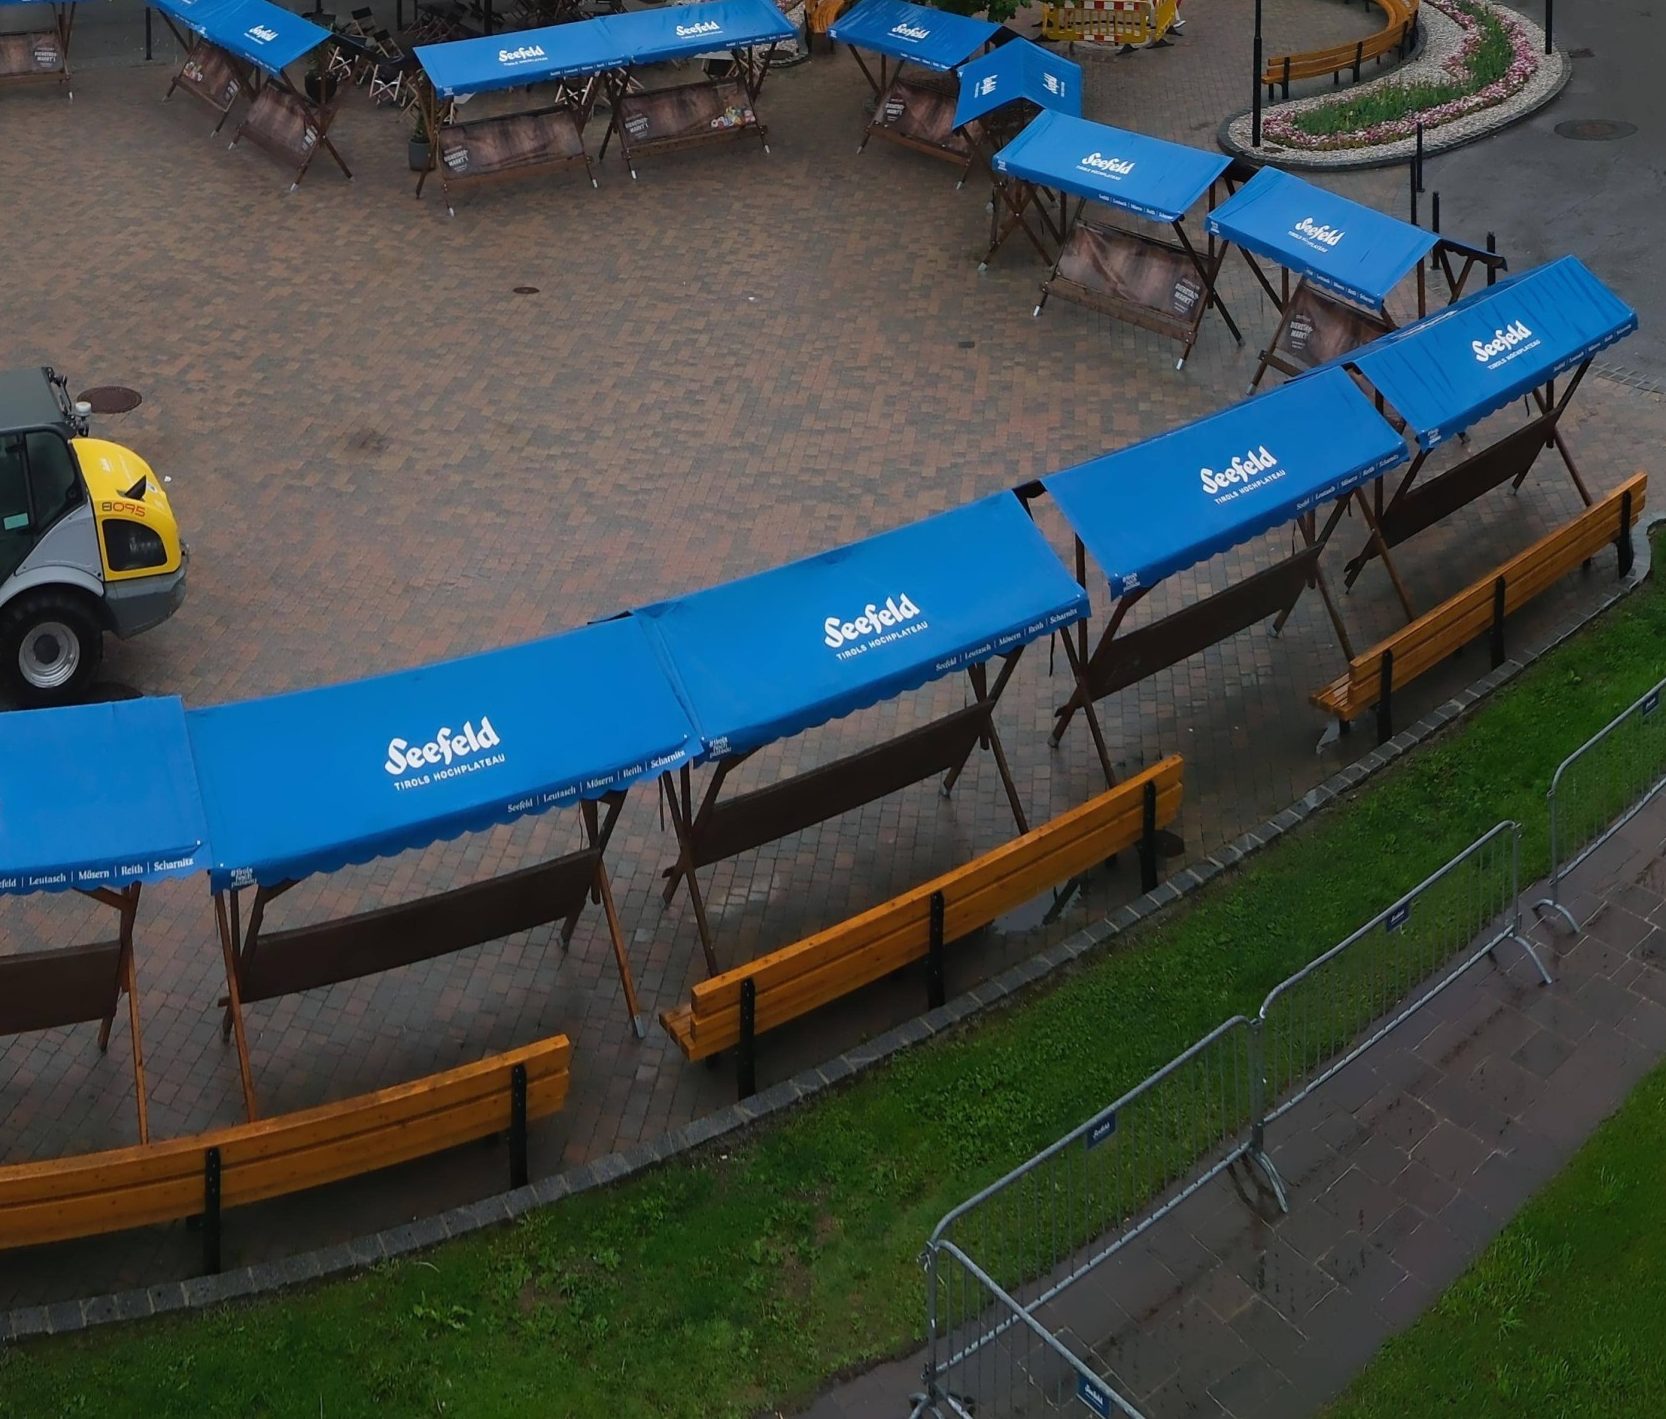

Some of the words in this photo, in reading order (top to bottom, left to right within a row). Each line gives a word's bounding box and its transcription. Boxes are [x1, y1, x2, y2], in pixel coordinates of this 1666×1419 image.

[676, 20, 720, 37] Seefeld
[891, 23, 931, 39] Seefeld
[498, 45, 545, 62] Seefeld
[1081, 151, 1135, 175] Seefeld
[1295, 217, 1345, 246] Seefeld
[1472, 319, 1532, 363] Seefeld
[1200, 445, 1278, 494] Seefeld
[102, 501, 146, 517] 8095
[824, 592, 921, 648] Seefeld
[836, 644, 867, 661] TIROLS
[868, 621, 929, 649] HOCHPLATEAU
[384, 715, 501, 775] Seefeld
[394, 775, 430, 791] TIROLS
[433, 753, 506, 782] HOCHPLATEAU
[507, 797, 533, 813] Seefeld
[543, 785, 576, 803] Leutasch
[586, 774, 614, 790] Mösern
[622, 763, 642, 779] Reith
[650, 748, 686, 769] Scharnitz
[29, 872, 66, 886] Leutasch
[78, 867, 110, 880] Mösern
[121, 862, 144, 876] Reith
[153, 856, 194, 872] Scharnitz
